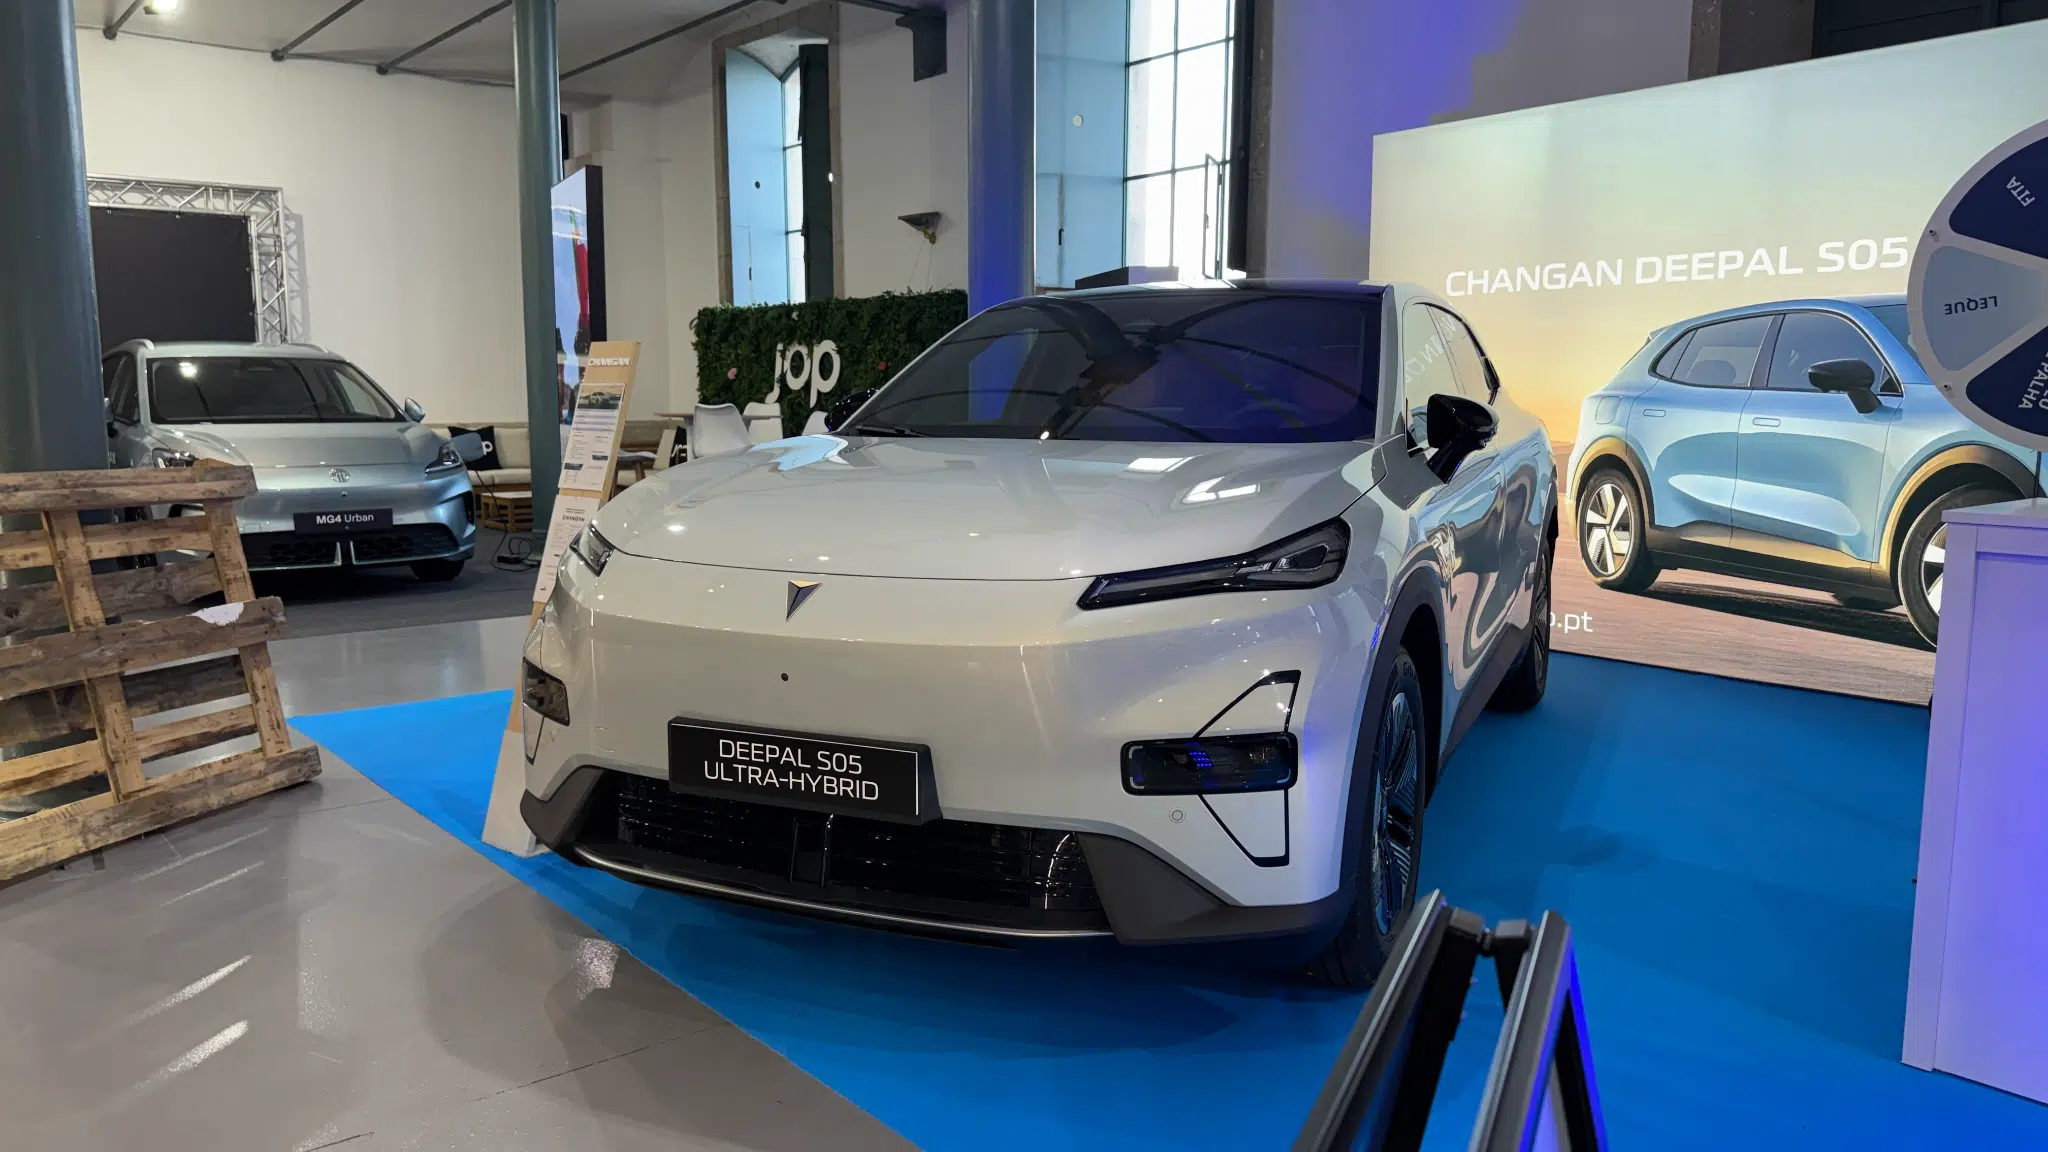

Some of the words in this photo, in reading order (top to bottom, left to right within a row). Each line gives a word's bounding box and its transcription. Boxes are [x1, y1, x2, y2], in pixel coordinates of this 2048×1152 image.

[2005, 175, 2036, 207] FITA
[1446, 259, 1622, 297] CHANGAN
[1635, 246, 1802, 285] DEEPAL
[1816, 236, 1909, 273] S05
[1943, 295, 1998, 315] LEQUE
[764, 339, 841, 408] jop
[316, 514, 342, 525] MG4
[344, 513, 374, 523] Urban
[719, 739, 812, 769] DEEPAL
[817, 750, 863, 775] S05
[704, 760, 879, 801] ULTRA-HYBRID
